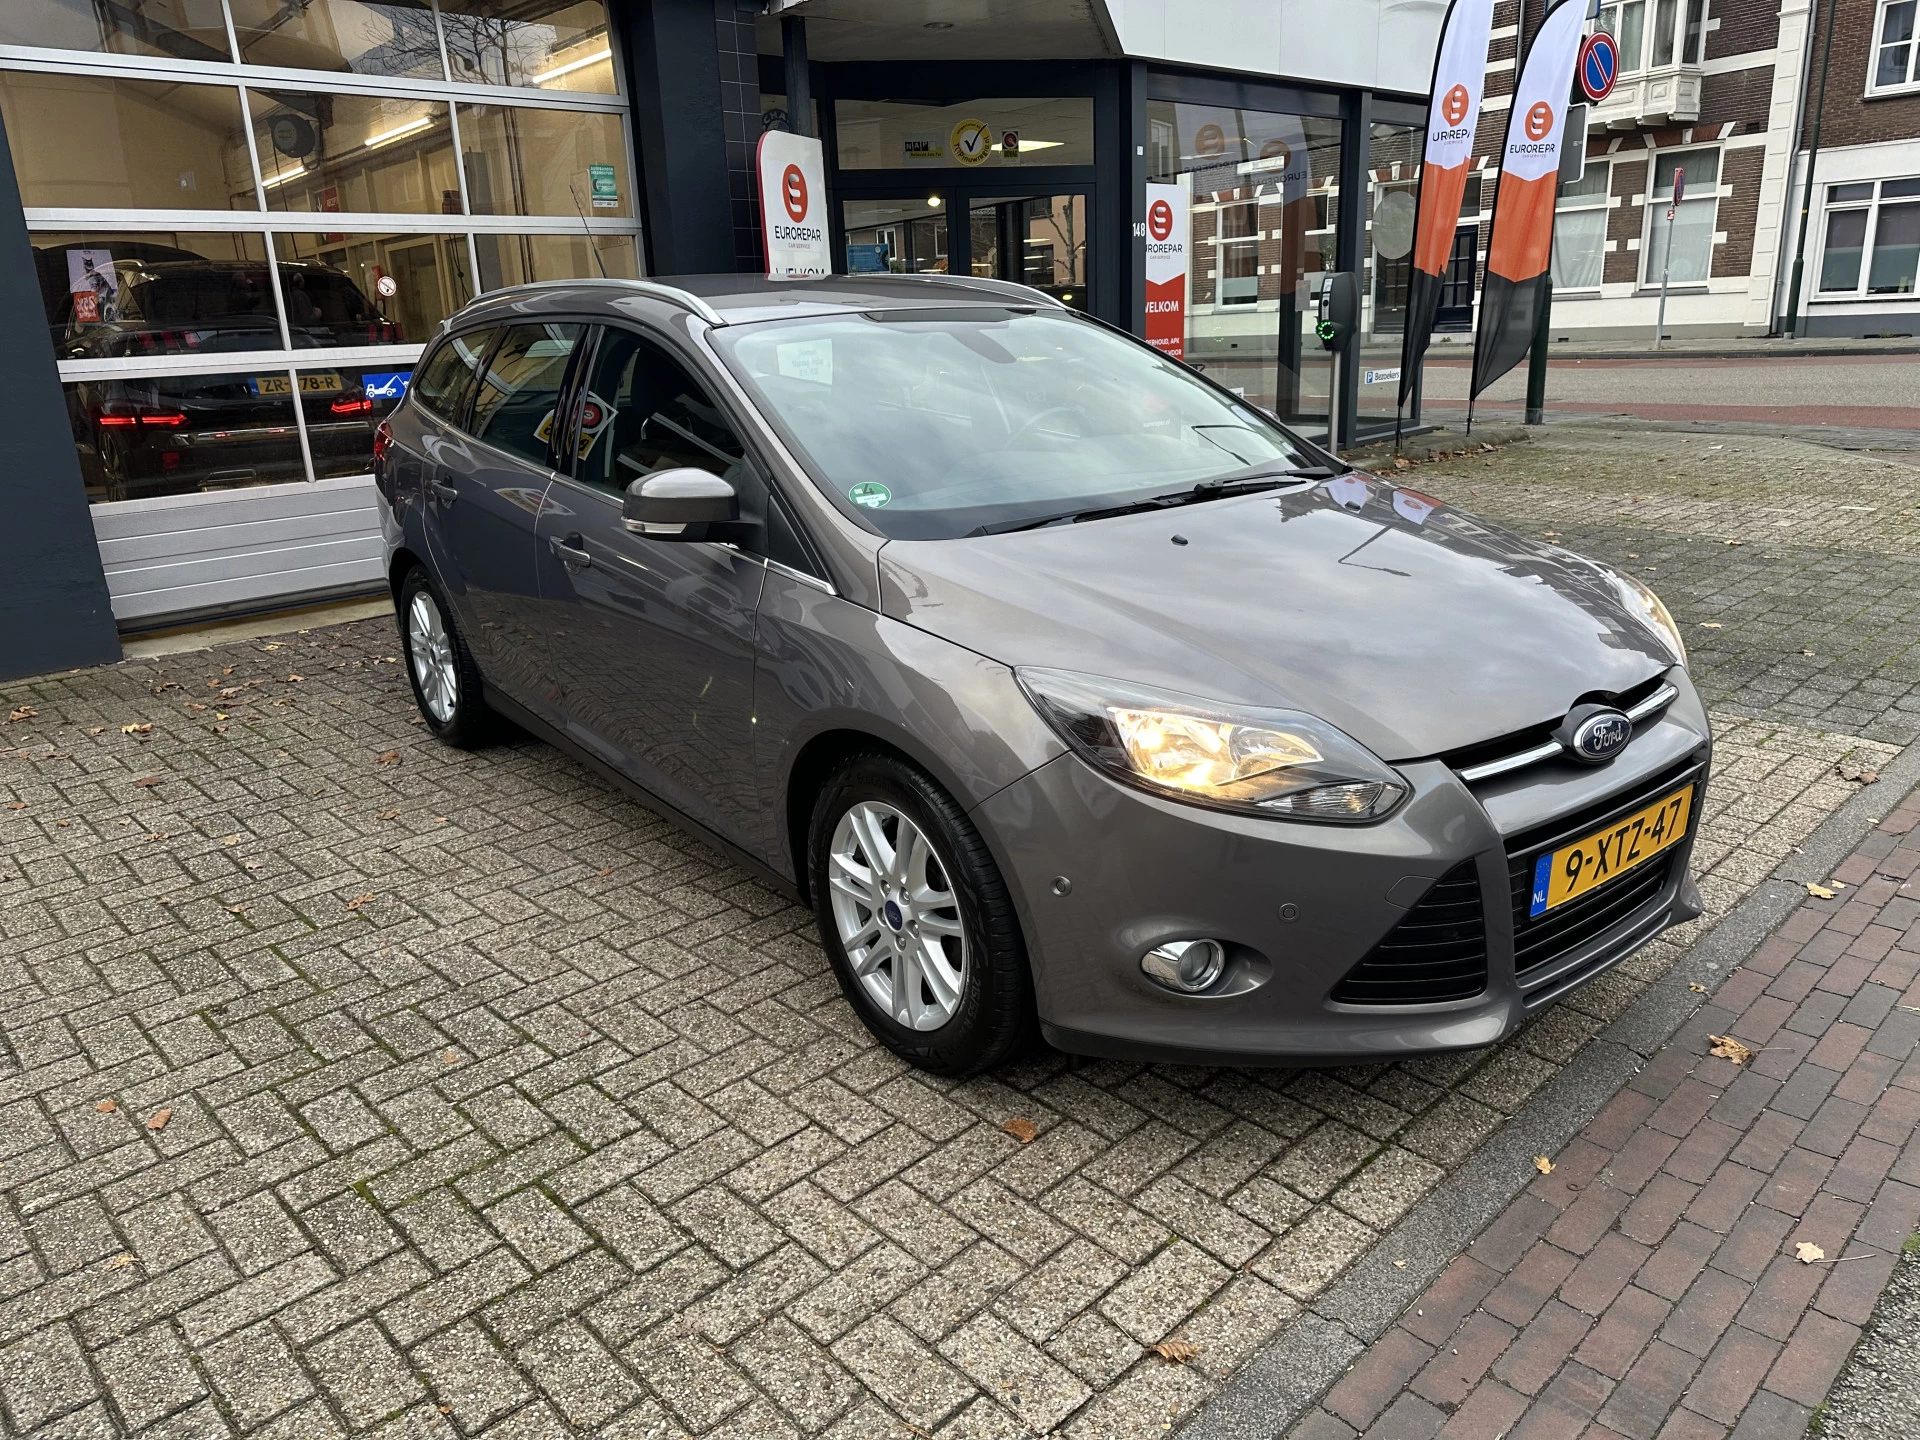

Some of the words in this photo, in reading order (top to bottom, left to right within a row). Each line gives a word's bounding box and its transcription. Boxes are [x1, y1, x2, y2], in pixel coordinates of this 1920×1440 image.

[763, 110, 789, 125] CHA
[774, 225, 822, 242] EUROREPAR
[1132, 222, 1146, 237] 148
[1375, 370, 1400, 381] Bezoekers
[262, 376, 337, 392] ZR-78-R
[1593, 720, 1624, 751] Ford
[1532, 890, 1546, 905] NL
[1565, 796, 1683, 893] 9-XTZ-47
